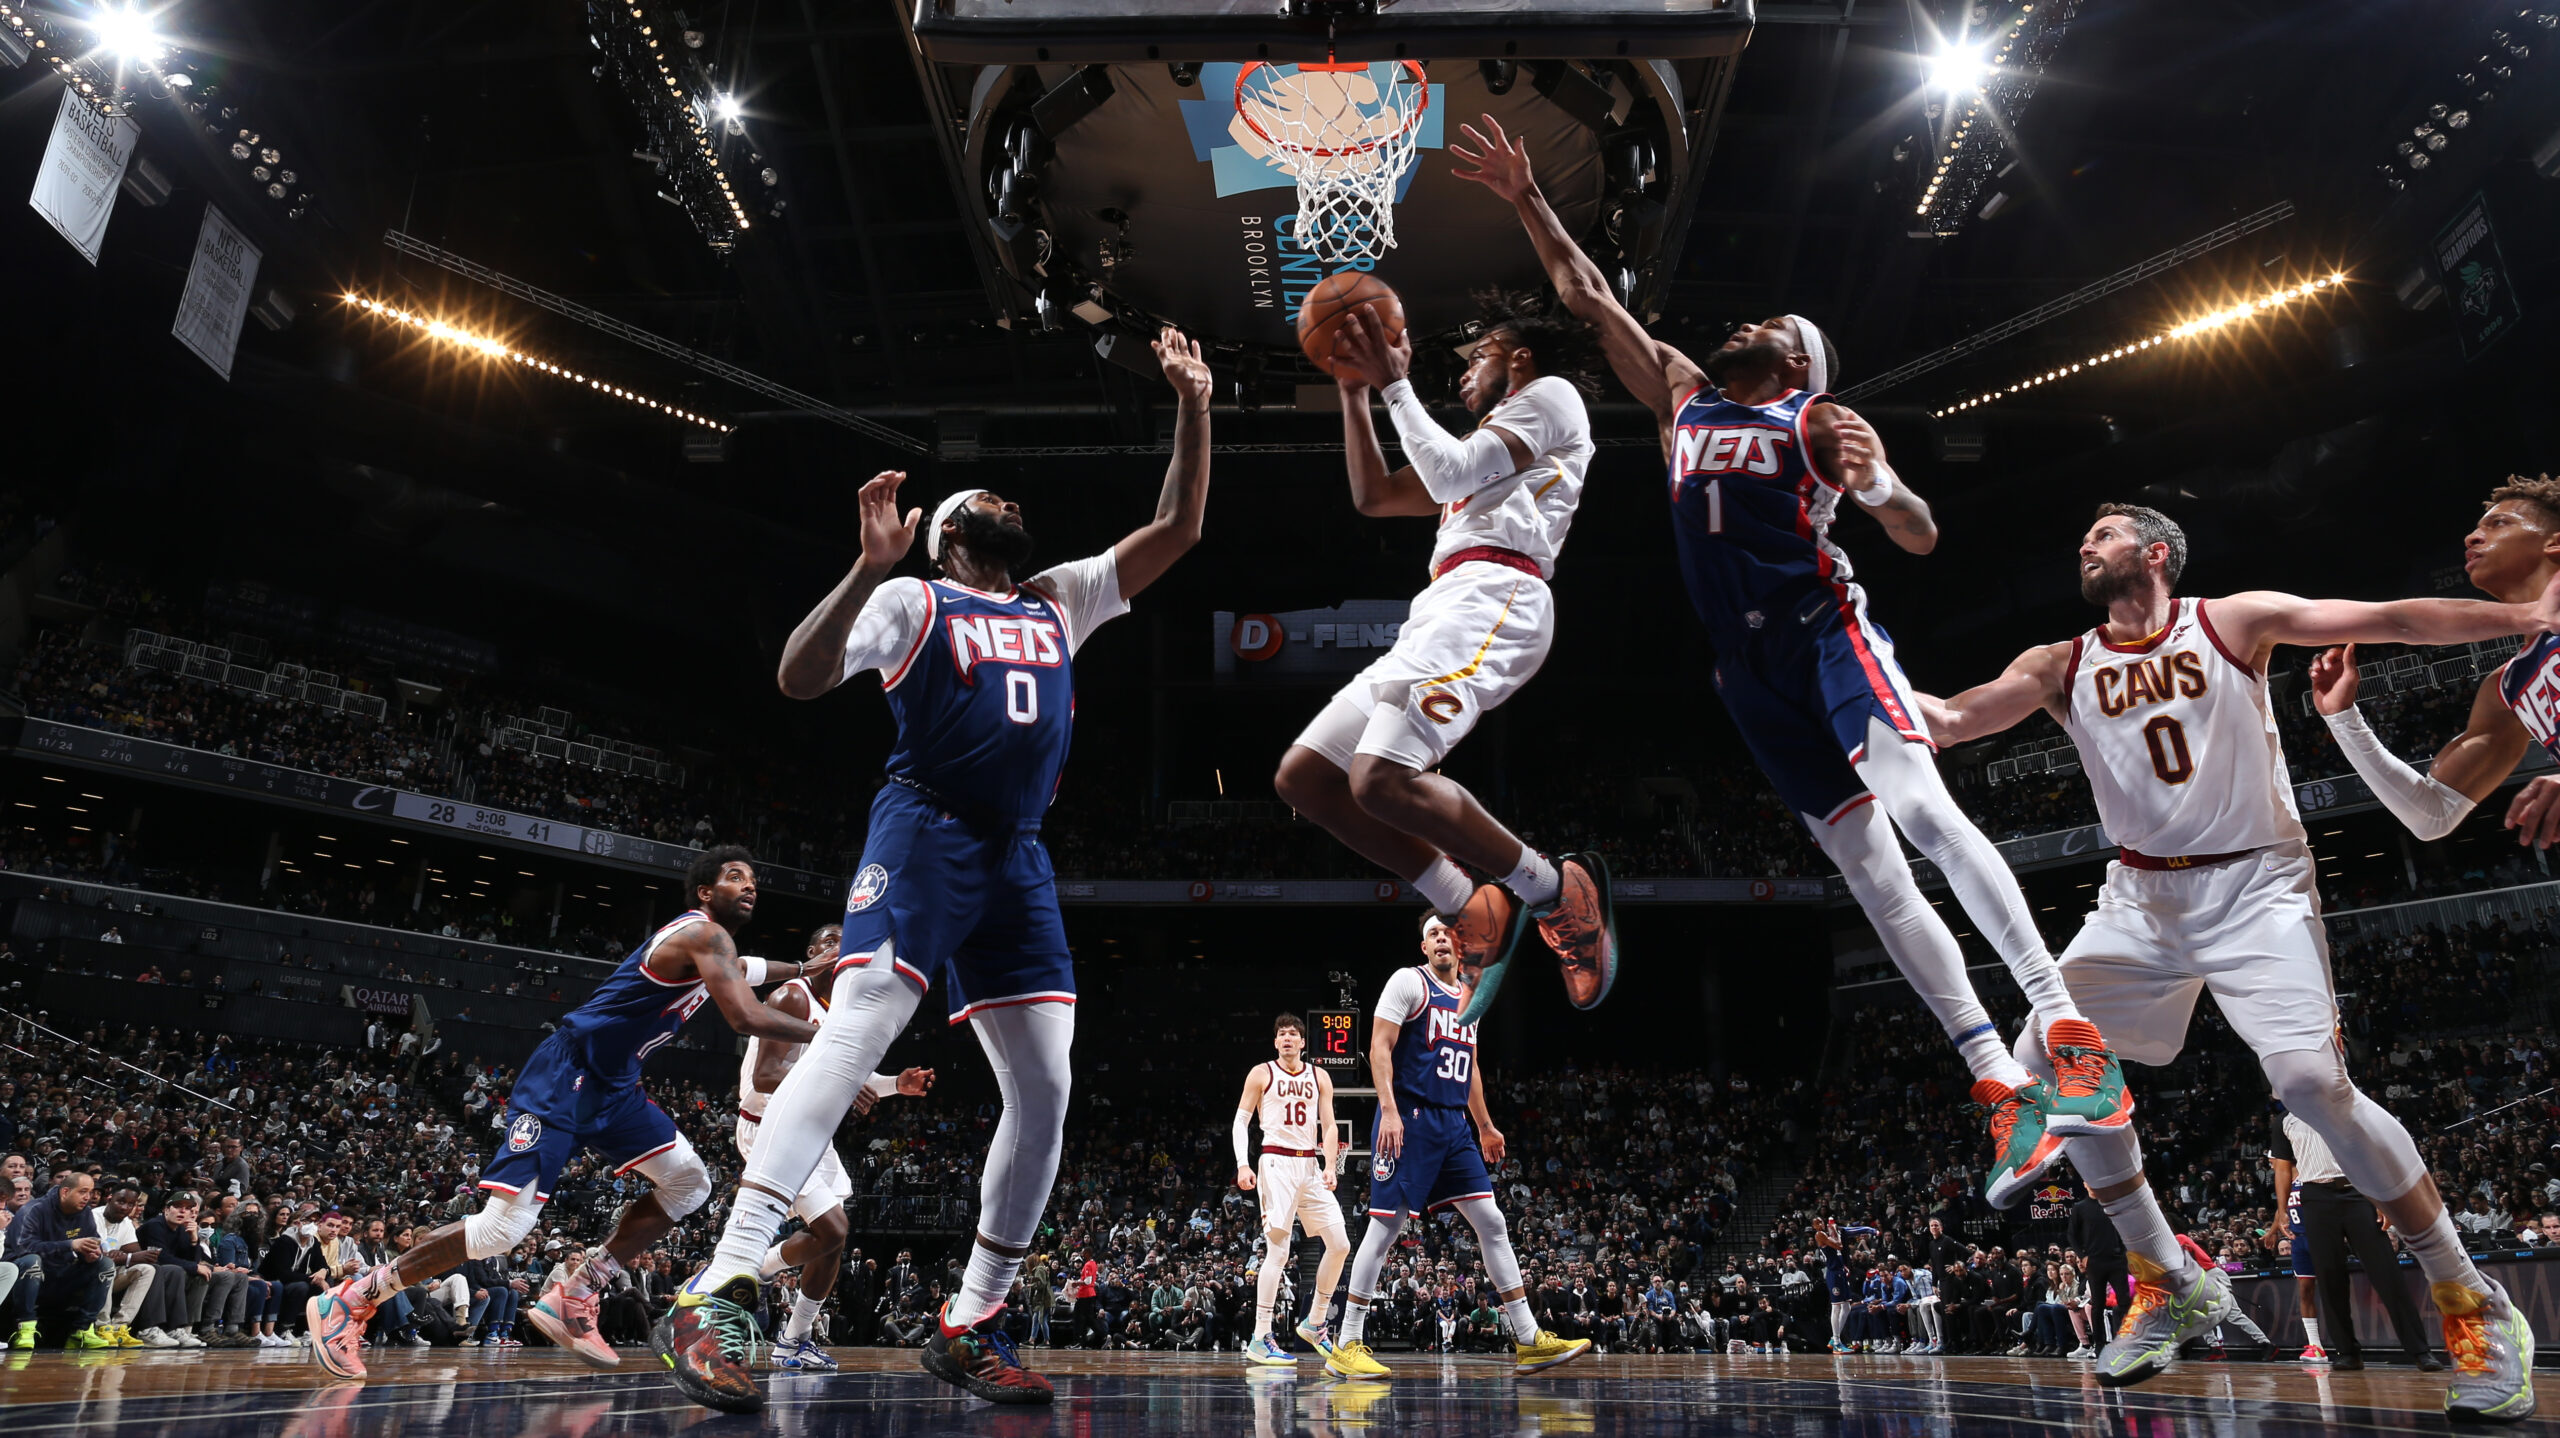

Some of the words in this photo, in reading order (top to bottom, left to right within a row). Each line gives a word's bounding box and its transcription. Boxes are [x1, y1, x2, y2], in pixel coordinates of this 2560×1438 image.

[68, 102, 122, 167] BASKETBALL
[217, 228, 243, 264] NETS
[2441, 216, 2488, 272] CHAMPIONS
[1241, 216, 1274, 308] BROOKLYN
[1673, 424, 1795, 502] NETS
[1704, 478, 1724, 534] 1
[945, 614, 1063, 686] NETS
[2094, 650, 2207, 718] CAVS
[1005, 668, 1040, 727] 0
[49, 727, 67, 738] FG
[108, 738, 132, 750] 3PT
[2144, 714, 2194, 786] 0
[170, 751, 187, 761] FT
[222, 760, 246, 772] REB
[260, 767, 283, 780] AST
[227, 772, 236, 783] 9
[265, 780, 274, 790] 5
[322, 779, 330, 789] 3
[429, 802, 456, 824] 28
[475, 810, 507, 827] 9:08
[466, 822, 481, 833] 2nd
[483, 825, 513, 838] Quarter
[527, 822, 550, 842] 41
[2167, 856, 2191, 869] CLE
[356, 988, 410, 1006] QATAR
[366, 1001, 409, 1016] AIRWAYS
[1322, 1015, 1352, 1029] 9:08
[1326, 1029, 1349, 1054] 12
[1322, 1057, 1356, 1065] TISSOT
[1436, 1046, 1471, 1084] 30
[1277, 1079, 1314, 1100] CAVS
[1283, 1101, 1307, 1126] 16
[2030, 1204, 2056, 1220] Red
[2289, 1208, 2301, 1225] 8
